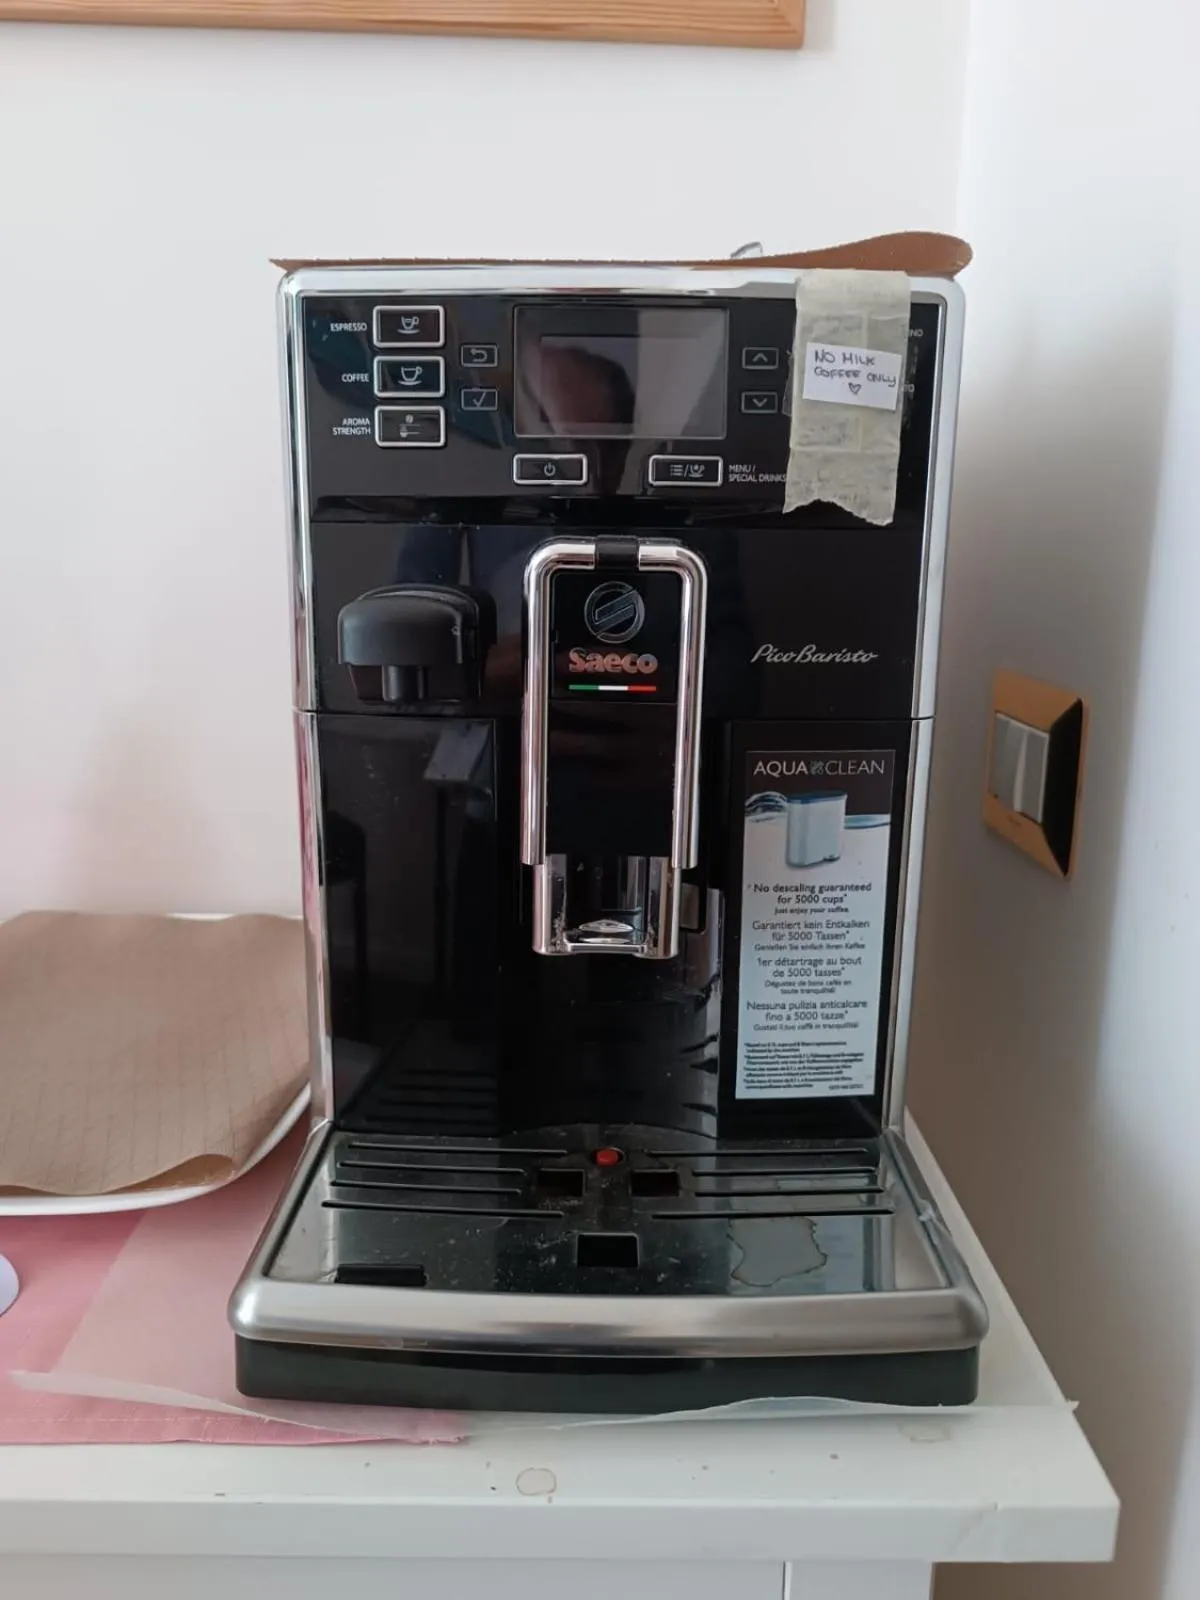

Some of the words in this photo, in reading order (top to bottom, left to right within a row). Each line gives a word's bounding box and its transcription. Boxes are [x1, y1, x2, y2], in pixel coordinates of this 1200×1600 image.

[330, 323, 367, 332] ESPRESSO
[815, 349, 836, 364] NO
[842, 352, 876, 366] MILK
[341, 373, 370, 382] COFFEE
[814, 366, 862, 380] COFFEE
[866, 372, 897, 388] ONLY
[342, 418, 370, 426] AROMA
[332, 427, 371, 436] STRENGTH
[728, 474, 757, 482] SPECIAL
[568, 646, 659, 674] Saeco
[753, 760, 808, 778] AQUA
[824, 760, 885, 776] CLEAN
[753, 884, 770, 893] No
[773, 883, 816, 894] descaling
[818, 883, 872, 894] guaranteed
[777, 894, 791, 904] for
[795, 895, 819, 904] 5000
[752, 920, 801, 930] Garantiert
[804, 920, 822, 929] kein
[826, 920, 870, 929] Entkalken
[772, 931, 785, 941] für
[788, 931, 812, 941] 5000
[757, 958, 771, 967] 1er
[774, 957, 824, 968] détartrage
[826, 958, 838, 966] au
[840, 957, 862, 965] bout
[772, 969, 785, 977] de
[788, 968, 812, 977] 5000
[746, 1000, 786, 1010] Nessuna
[788, 1000, 817, 1011] pulizia
[820, 1000, 868, 1009] anticalcare
[765, 1011, 783, 1021] fino
[794, 1011, 818, 1021] 5000
